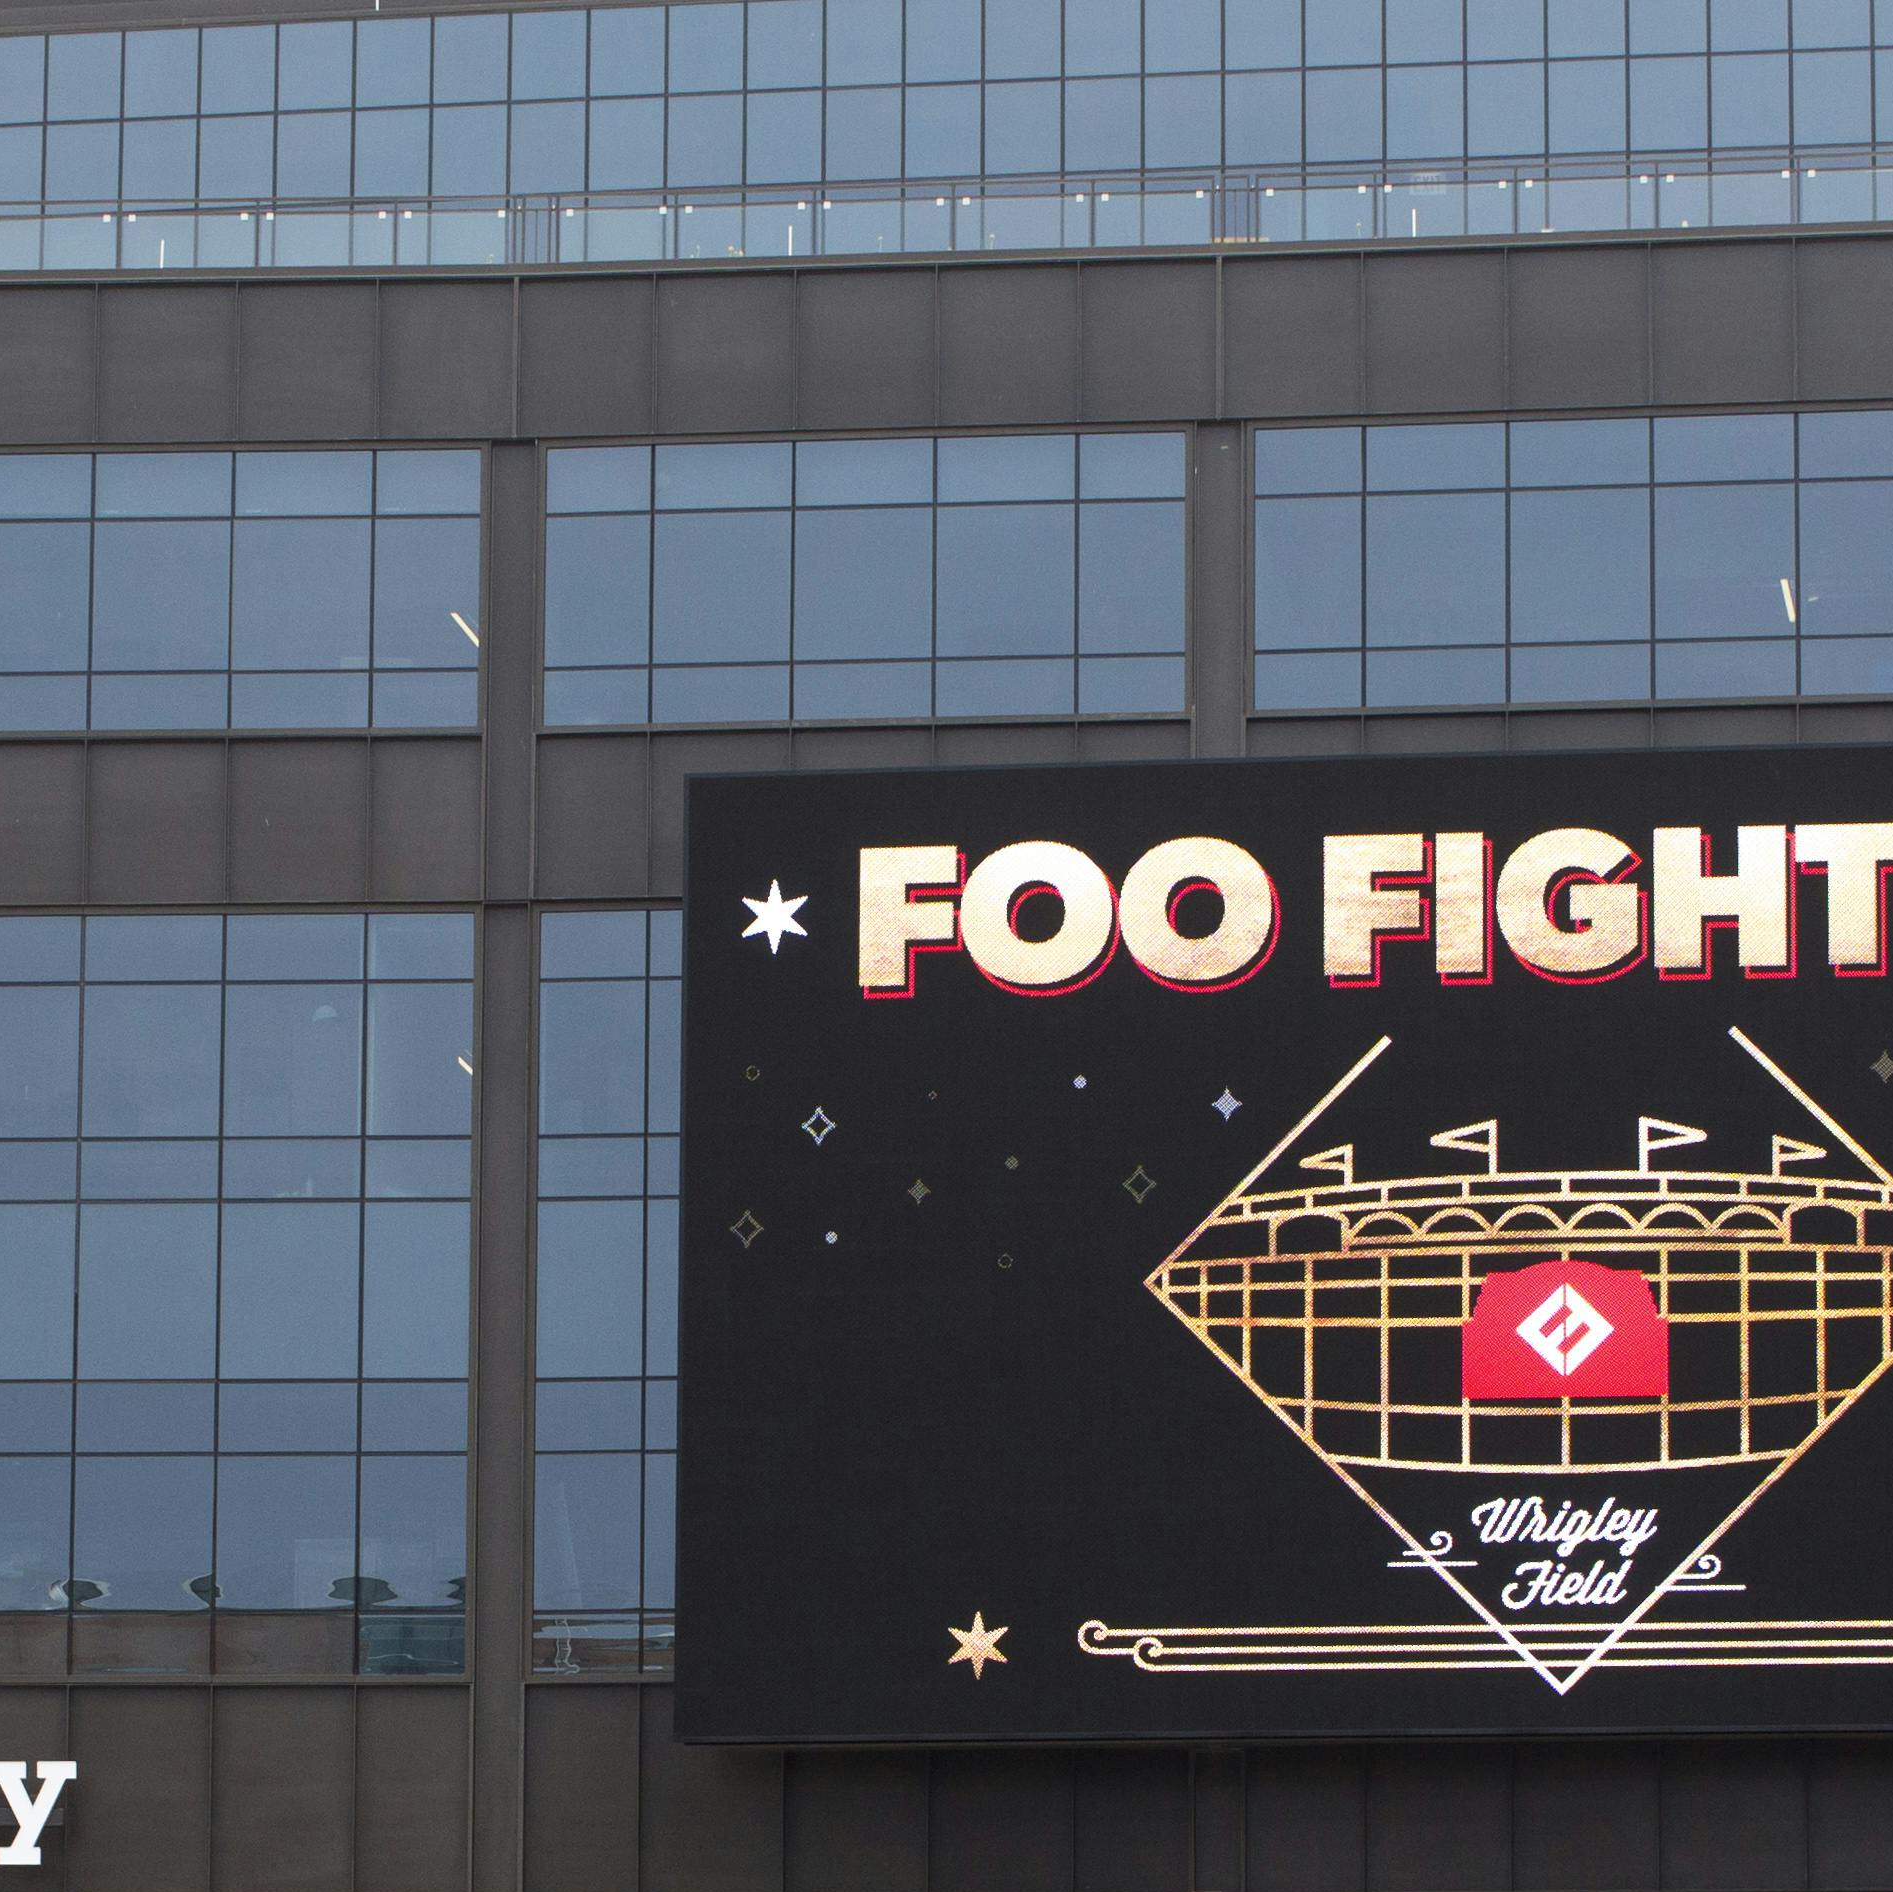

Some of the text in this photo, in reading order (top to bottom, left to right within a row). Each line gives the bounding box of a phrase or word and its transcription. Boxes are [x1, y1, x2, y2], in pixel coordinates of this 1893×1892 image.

[858, 836, 1282, 1000] FOO
[1471, 1495, 1659, 1558] Wrigley
[1500, 1559, 1634, 1611] Field
